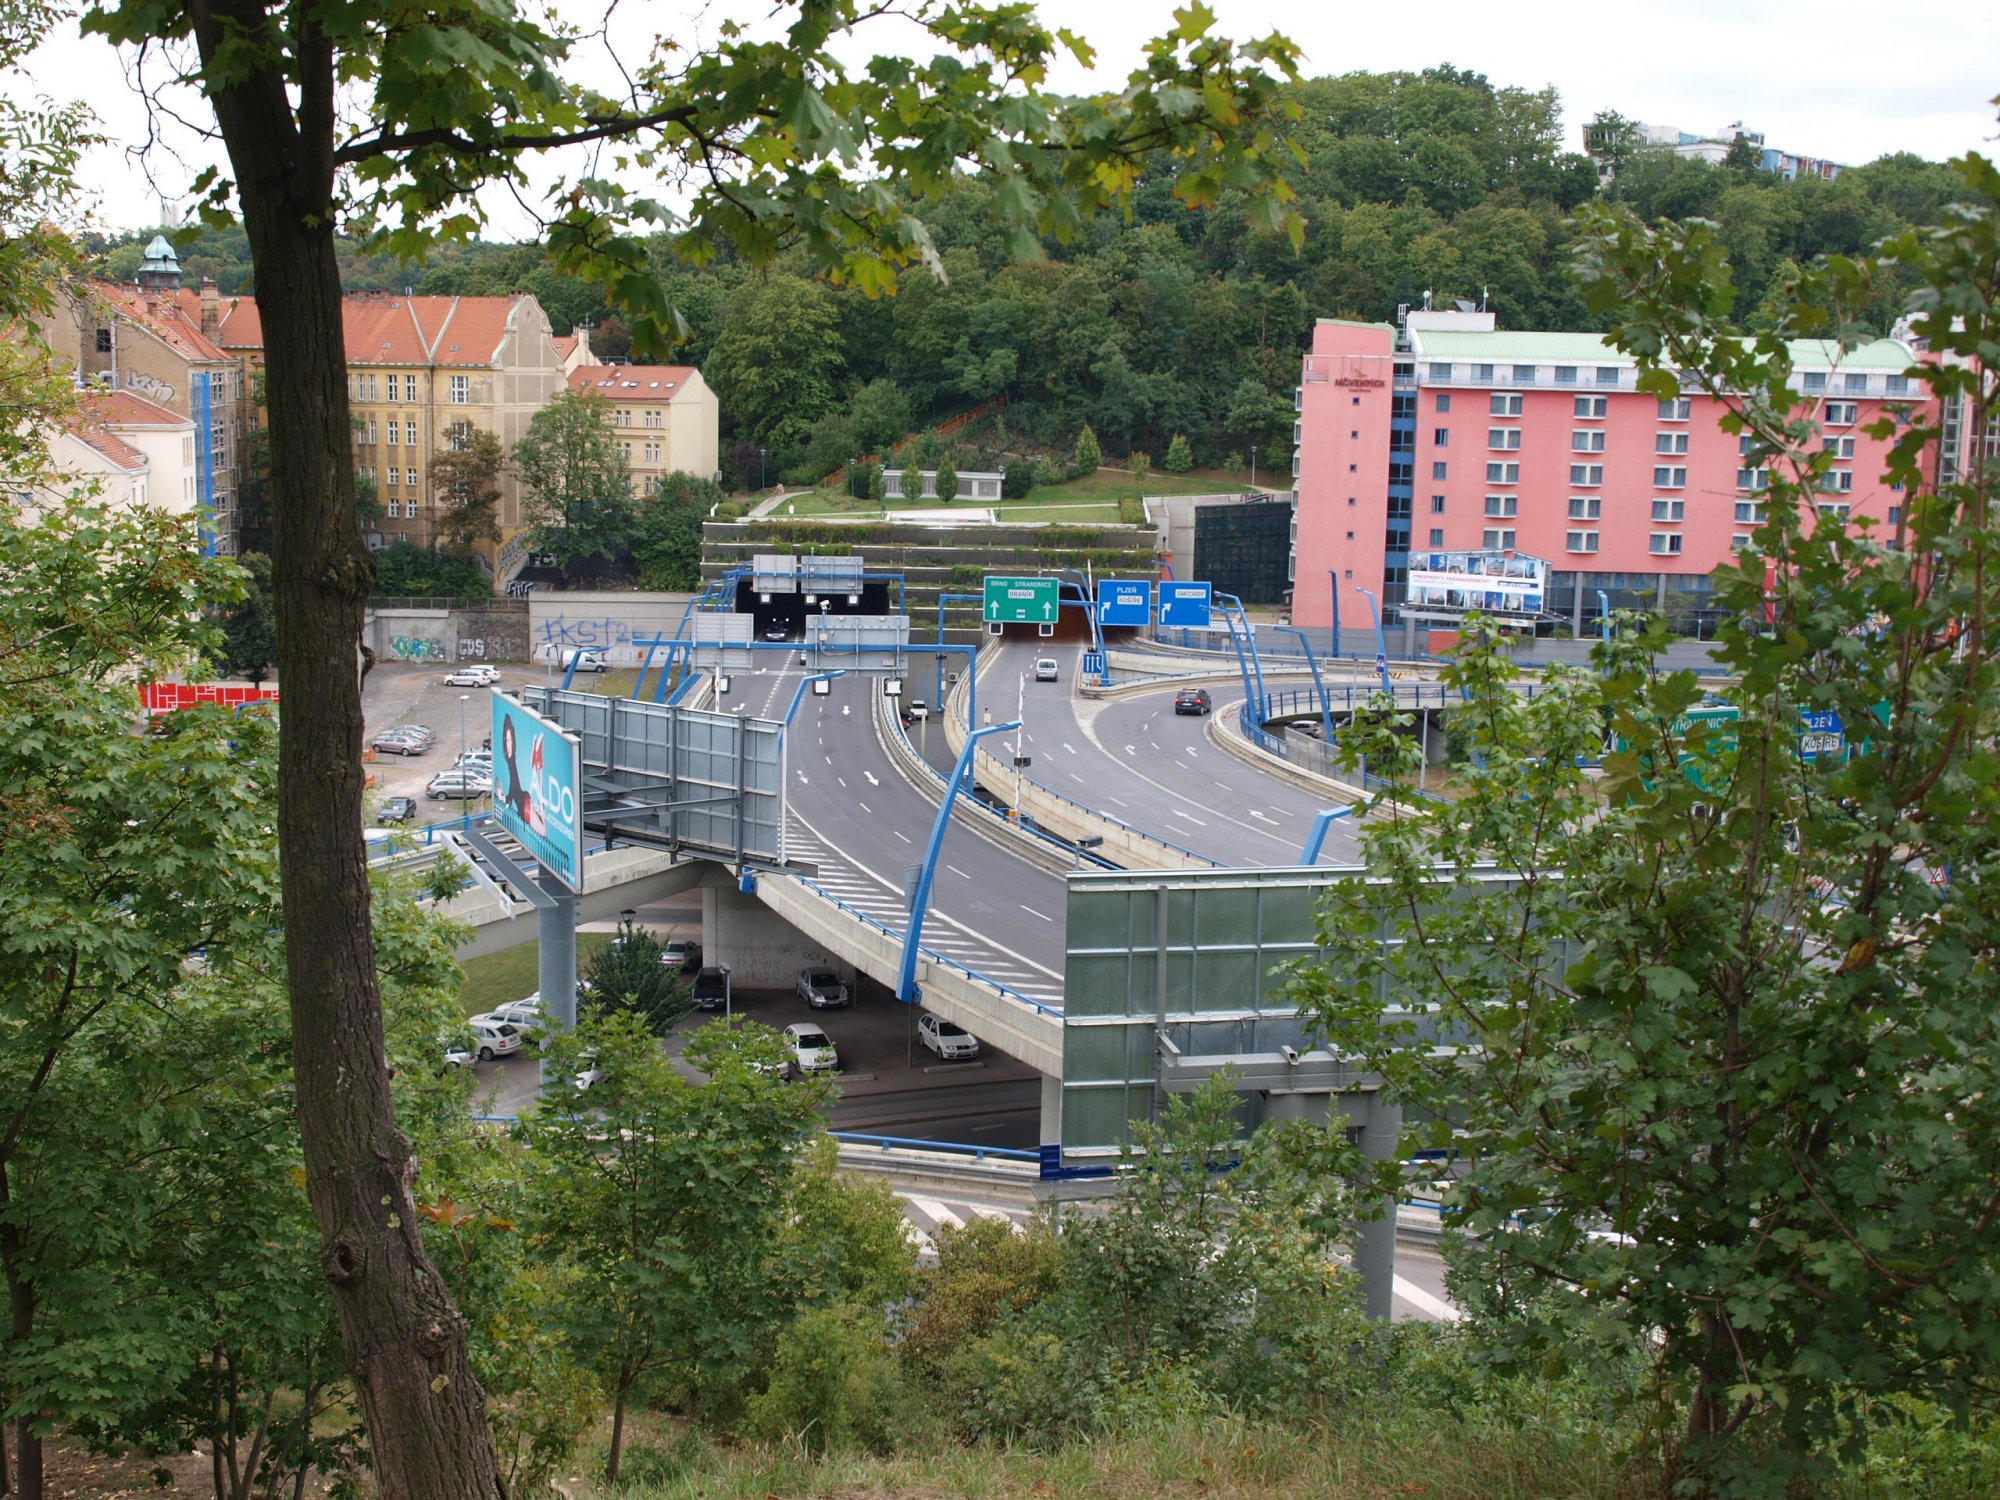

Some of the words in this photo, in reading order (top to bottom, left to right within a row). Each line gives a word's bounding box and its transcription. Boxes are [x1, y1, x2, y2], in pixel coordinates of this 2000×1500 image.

[1413, 573, 1446, 582] PROPERTY
[1446, 576, 1491, 584] MANAGEMENT
[1014, 580, 1053, 589] STRAKONICE
[1009, 589, 1033, 598] BRANÍK
[1116, 586, 1137, 594] PLZEŇ
[1176, 590, 1205, 598] SMÍCHOV
[1808, 713, 1833, 729] LZEŇ
[529, 767, 575, 824] ALDO
